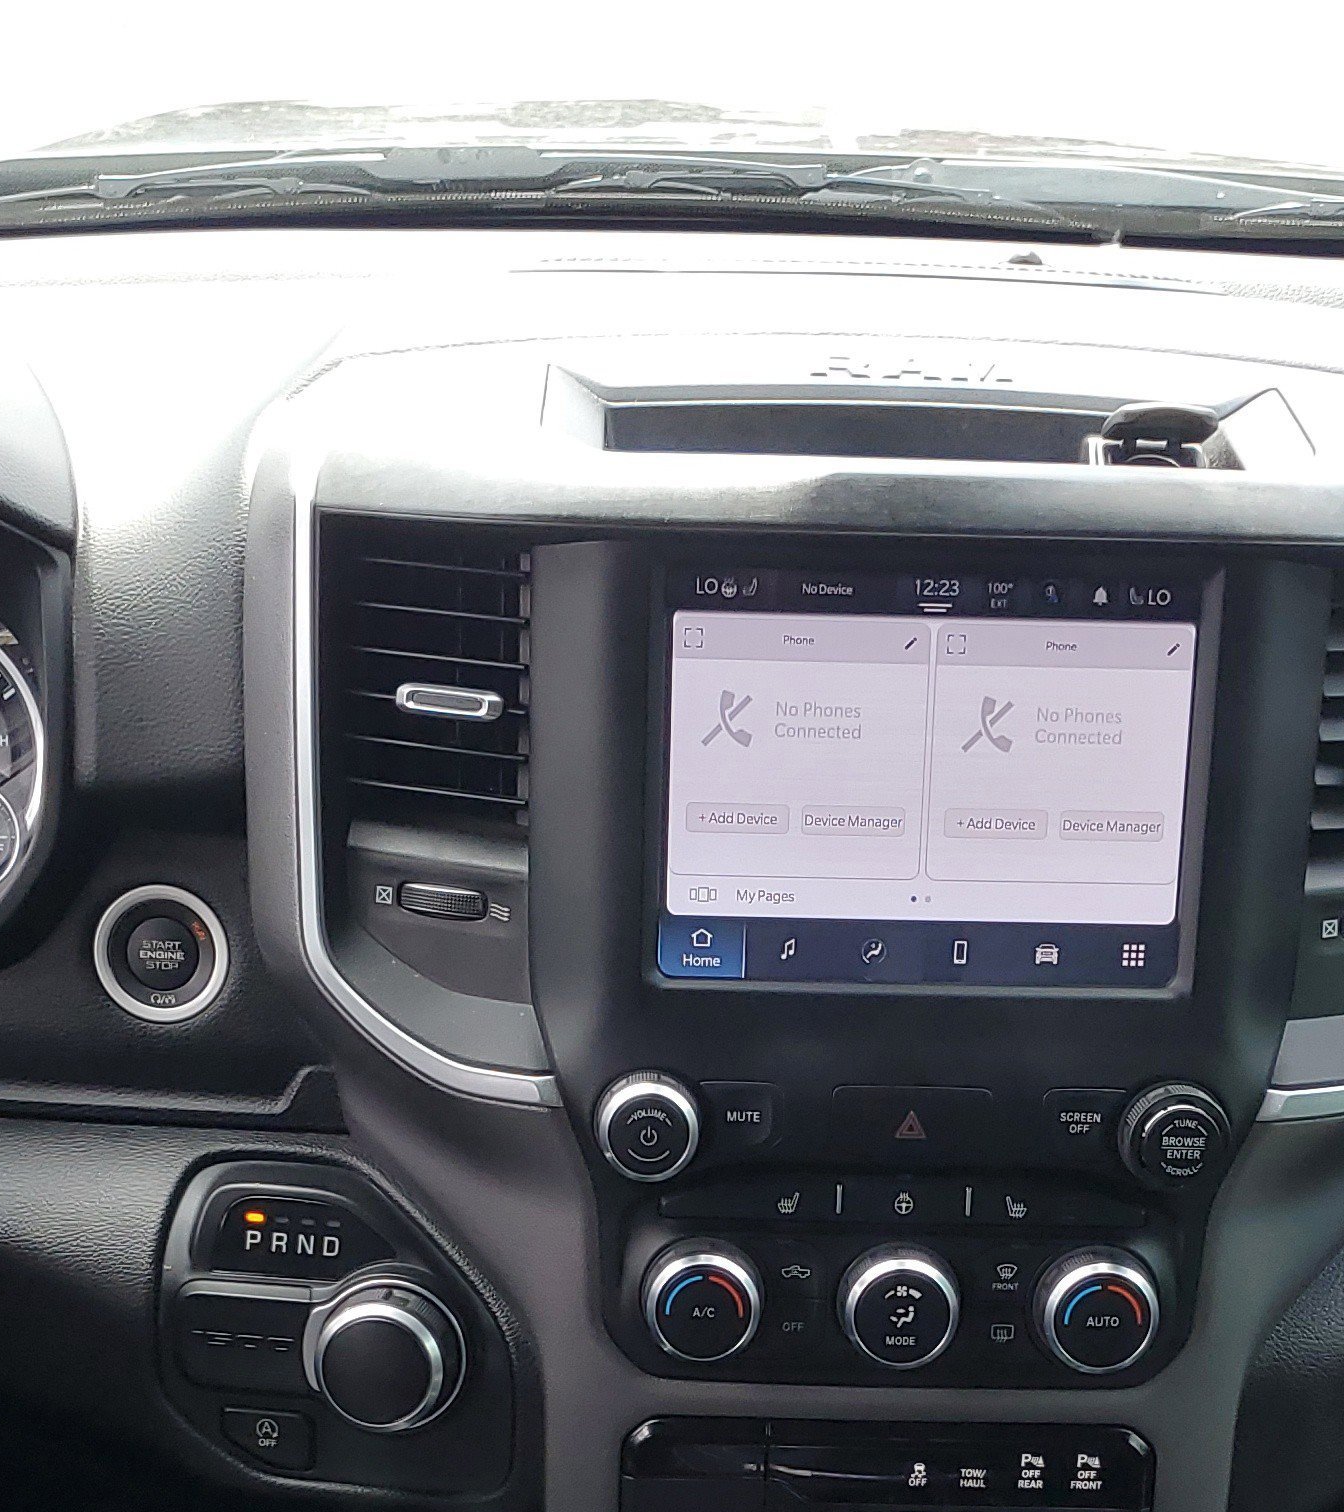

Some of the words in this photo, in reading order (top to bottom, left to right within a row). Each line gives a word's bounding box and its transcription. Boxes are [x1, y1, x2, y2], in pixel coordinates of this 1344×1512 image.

[696, 578, 719, 595] LO
[802, 583, 817, 595] No
[819, 583, 853, 596] Device
[915, 579, 960, 597] 12:23
[1147, 589, 1171, 606] LO
[783, 634, 815, 645] Phone
[1045, 641, 1077, 652] Phone
[775, 701, 798, 717] No
[803, 702, 862, 719] Phones
[1036, 707, 1059, 723] No
[1064, 708, 1122, 725] Phones
[774, 722, 862, 740] Connected
[1035, 728, 1123, 746] Connected
[708, 812, 733, 825] Add
[737, 812, 777, 825] Device
[804, 814, 845, 827] Device
[847, 815, 902, 830] Manager
[967, 818, 991, 830] Add
[995, 818, 1036, 831] Device
[1062, 820, 1104, 832] Device
[1106, 821, 1161, 835] Manager
[736, 890, 755, 904] My
[758, 890, 795, 904] Pages
[142, 941, 181, 949] START
[139, 950, 185, 960] ENGINE
[683, 954, 721, 967] Home
[146, 961, 179, 970] STOP
[632, 1109, 666, 1122] VOLUME
[726, 1111, 761, 1123] MUTE
[1060, 1112, 1101, 1123] SCREEN
[1069, 1124, 1090, 1134] OFF
[1174, 1119, 1199, 1129] TUNE
[1162, 1136, 1206, 1147] BROWSE
[1167, 1150, 1201, 1160] ENTER
[1165, 1165, 1199, 1177] SCROLL
[693, 1307, 715, 1318] A/C
[782, 1322, 804, 1332] OFF
[1086, 1316, 1120, 1328] AUTO
[886, 1336, 916, 1346] MODE
[258, 1438, 278, 1447] OFF
[960, 1468, 987, 1478] TOW/
[1021, 1469, 1041, 1479] OFF
[1077, 1470, 1097, 1480] OFF
[908, 1477, 928, 1487] OFF
[959, 1479, 986, 1488] HAUL
[1017, 1479, 1043, 1489] REAR
[1070, 1480, 1103, 1490] FRONT
